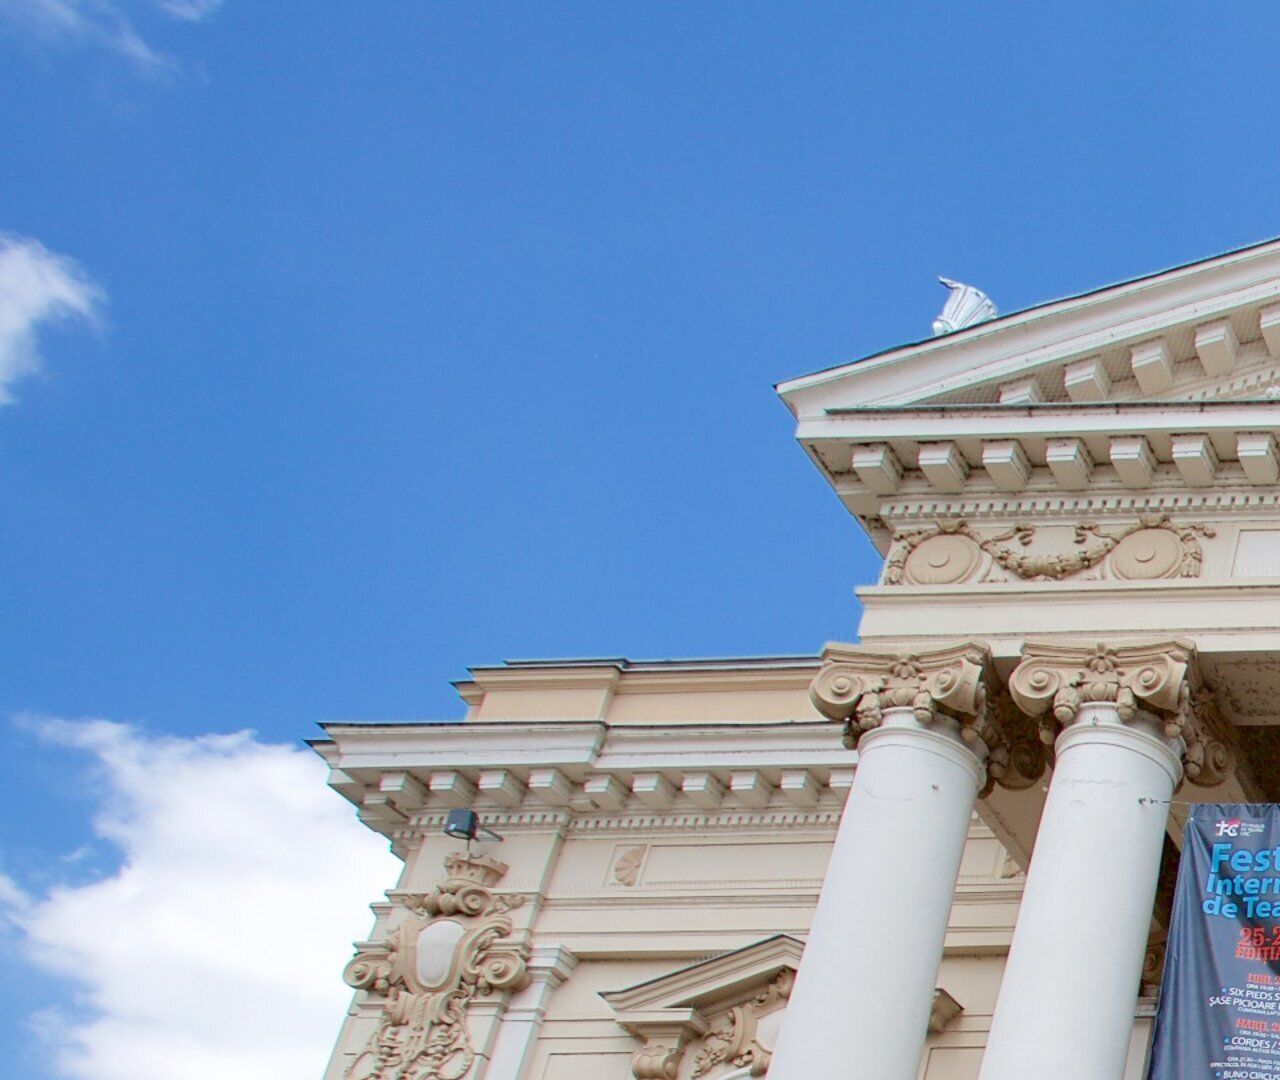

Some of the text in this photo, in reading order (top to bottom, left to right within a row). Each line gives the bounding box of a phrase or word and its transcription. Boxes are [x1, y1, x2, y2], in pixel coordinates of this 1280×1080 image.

[1202, 895, 1239, 919] de
[1229, 987, 1245, 997] SIX
[1246, 989, 1273, 1001] PIEDS
[1232, 998, 1276, 1010] PICIOARE
[1231, 1036, 1271, 1049] CORDES
[1249, 1071, 1280, 1080] CIRCUS
